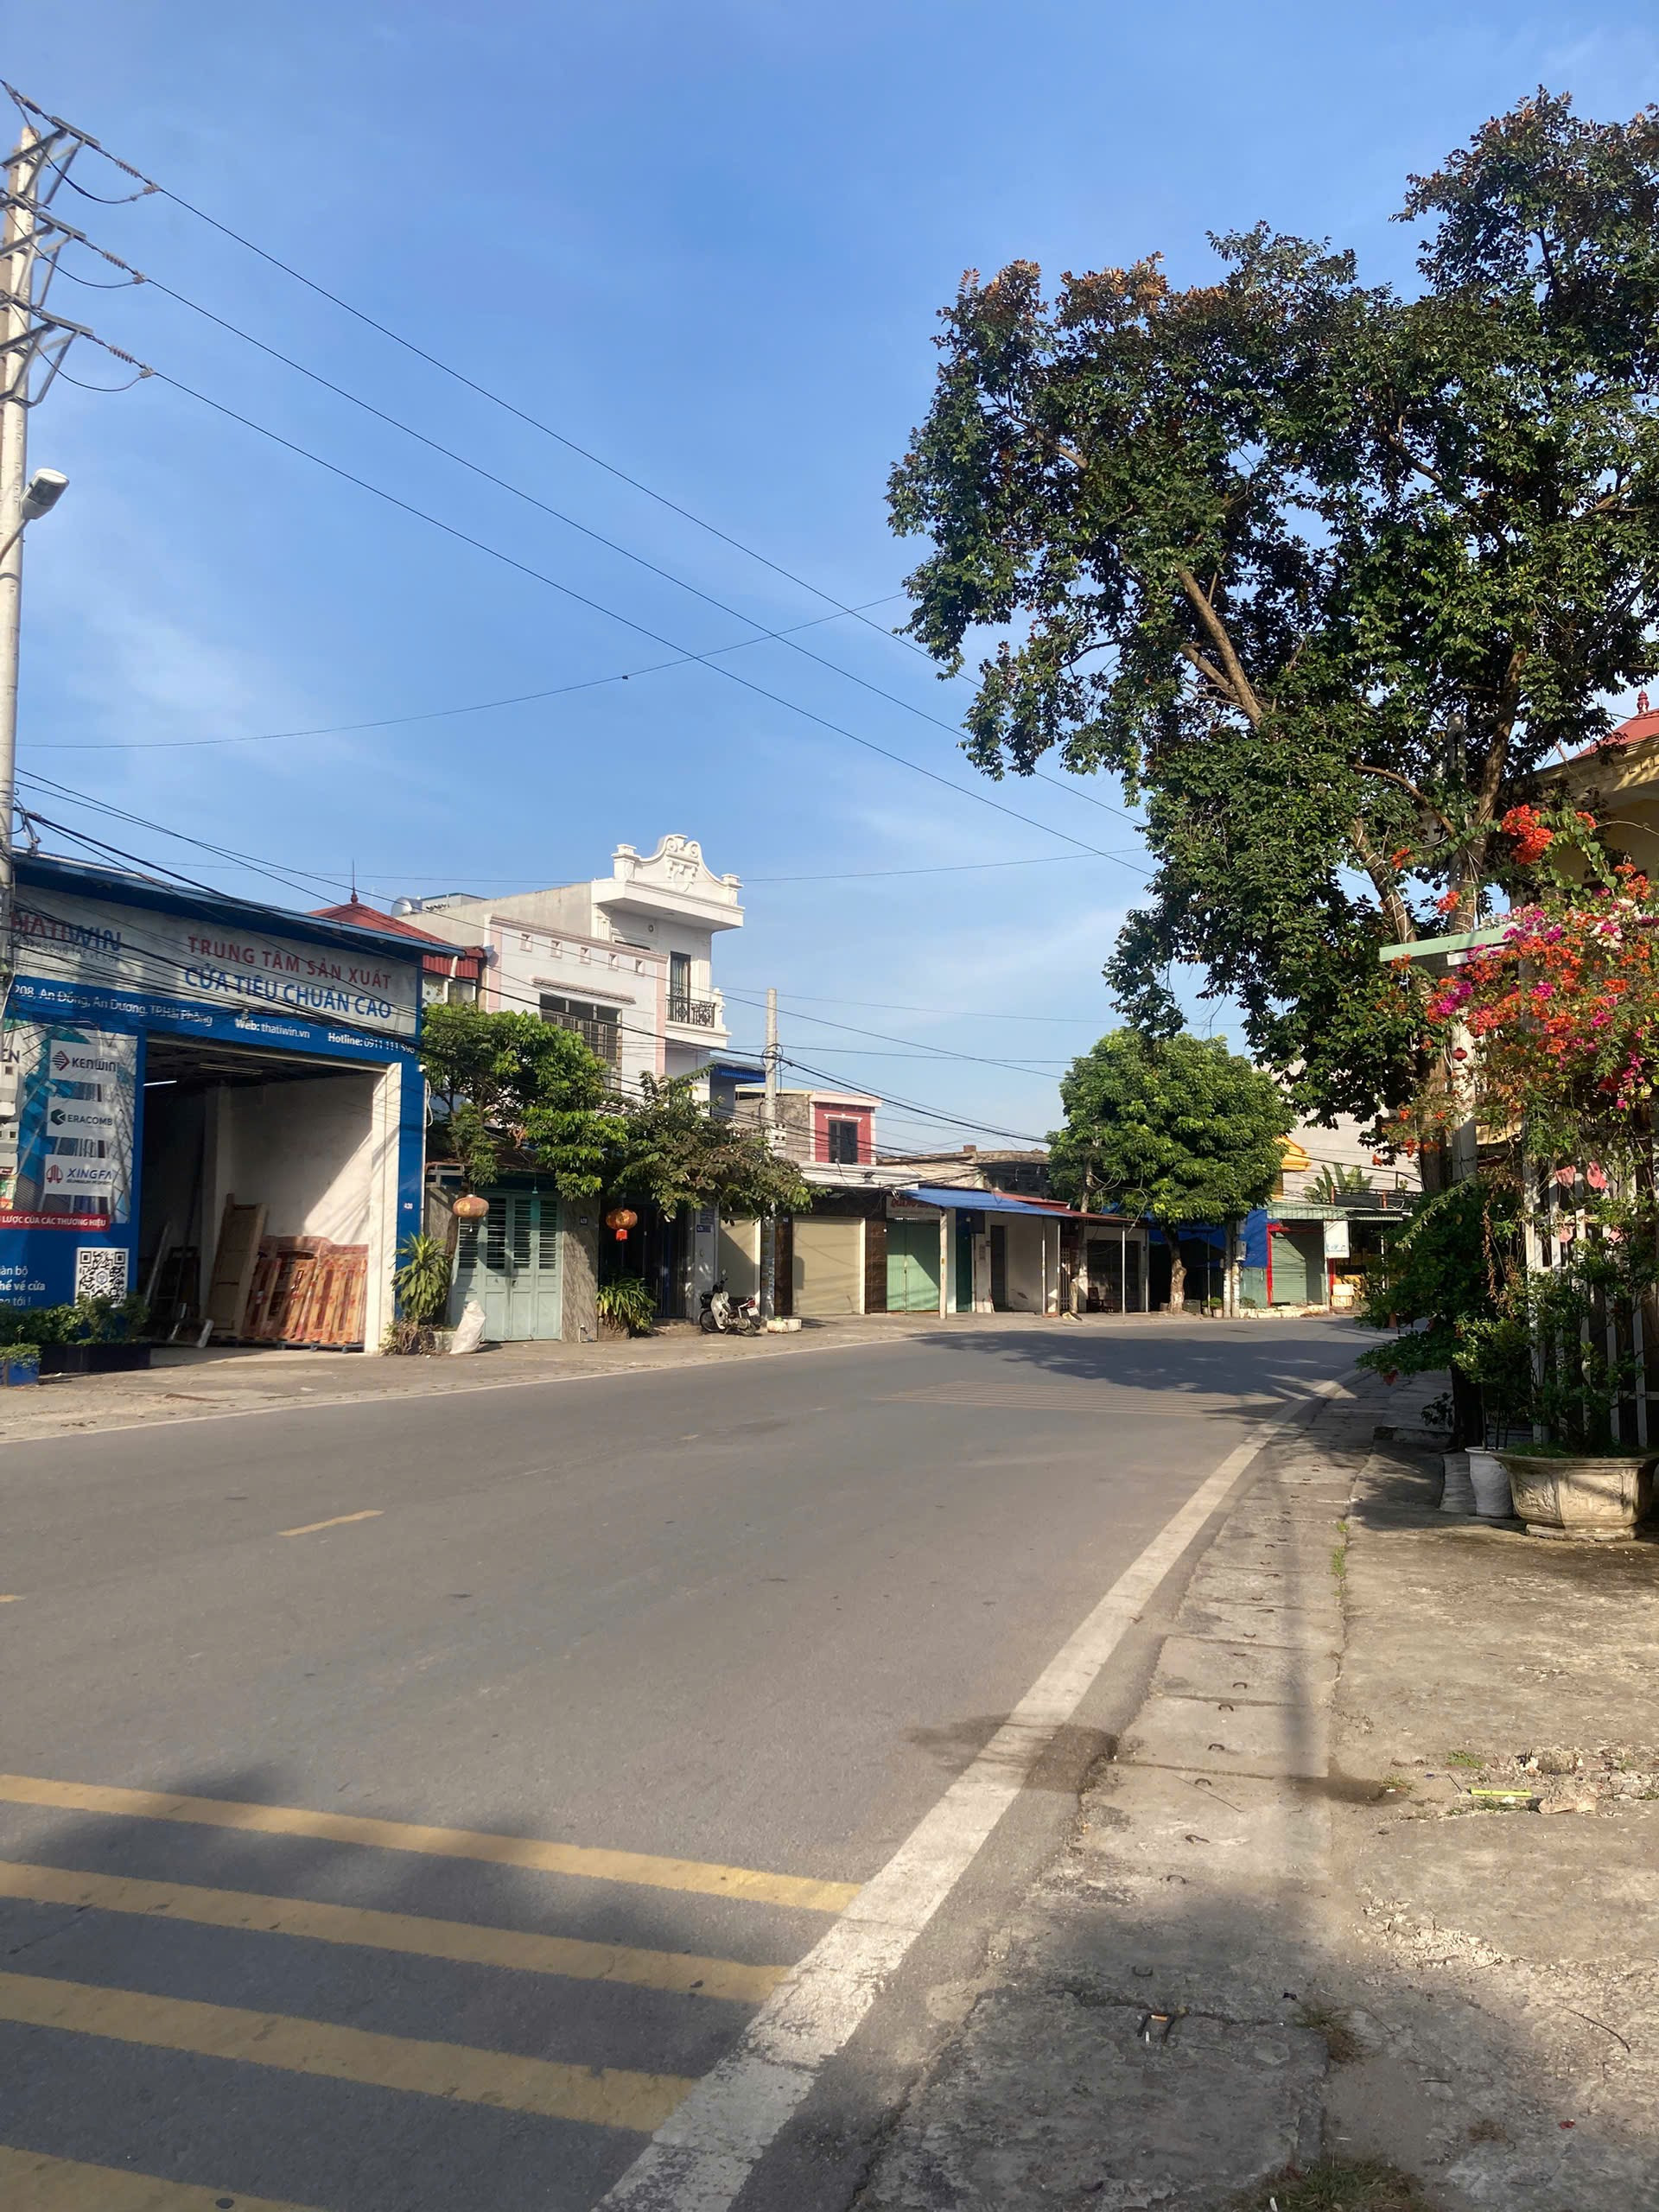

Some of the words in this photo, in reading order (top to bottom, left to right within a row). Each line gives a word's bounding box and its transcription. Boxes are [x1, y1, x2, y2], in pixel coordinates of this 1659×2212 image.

[188, 936, 255, 964] TRUNG
[262, 950, 299, 973] TÂM
[307, 957, 341, 981] SẢN
[348, 966, 391, 989] XUẤT
[283, 984, 350, 1013] CHUẨN
[355, 995, 392, 1019] CAO
[235, 1018, 260, 1032] Web:
[261, 1022, 311, 1039] thatiwin.vn
[328, 1032, 363, 1046] Hotline:
[67, 1167, 111, 1180] XINGFA
[41, 1215, 57, 1225] CÁC
[57, 1217, 88, 1226] THƯƠNG
[89, 1217, 106, 1228] HIỆU
[28, 1280, 46, 1291] cửa
